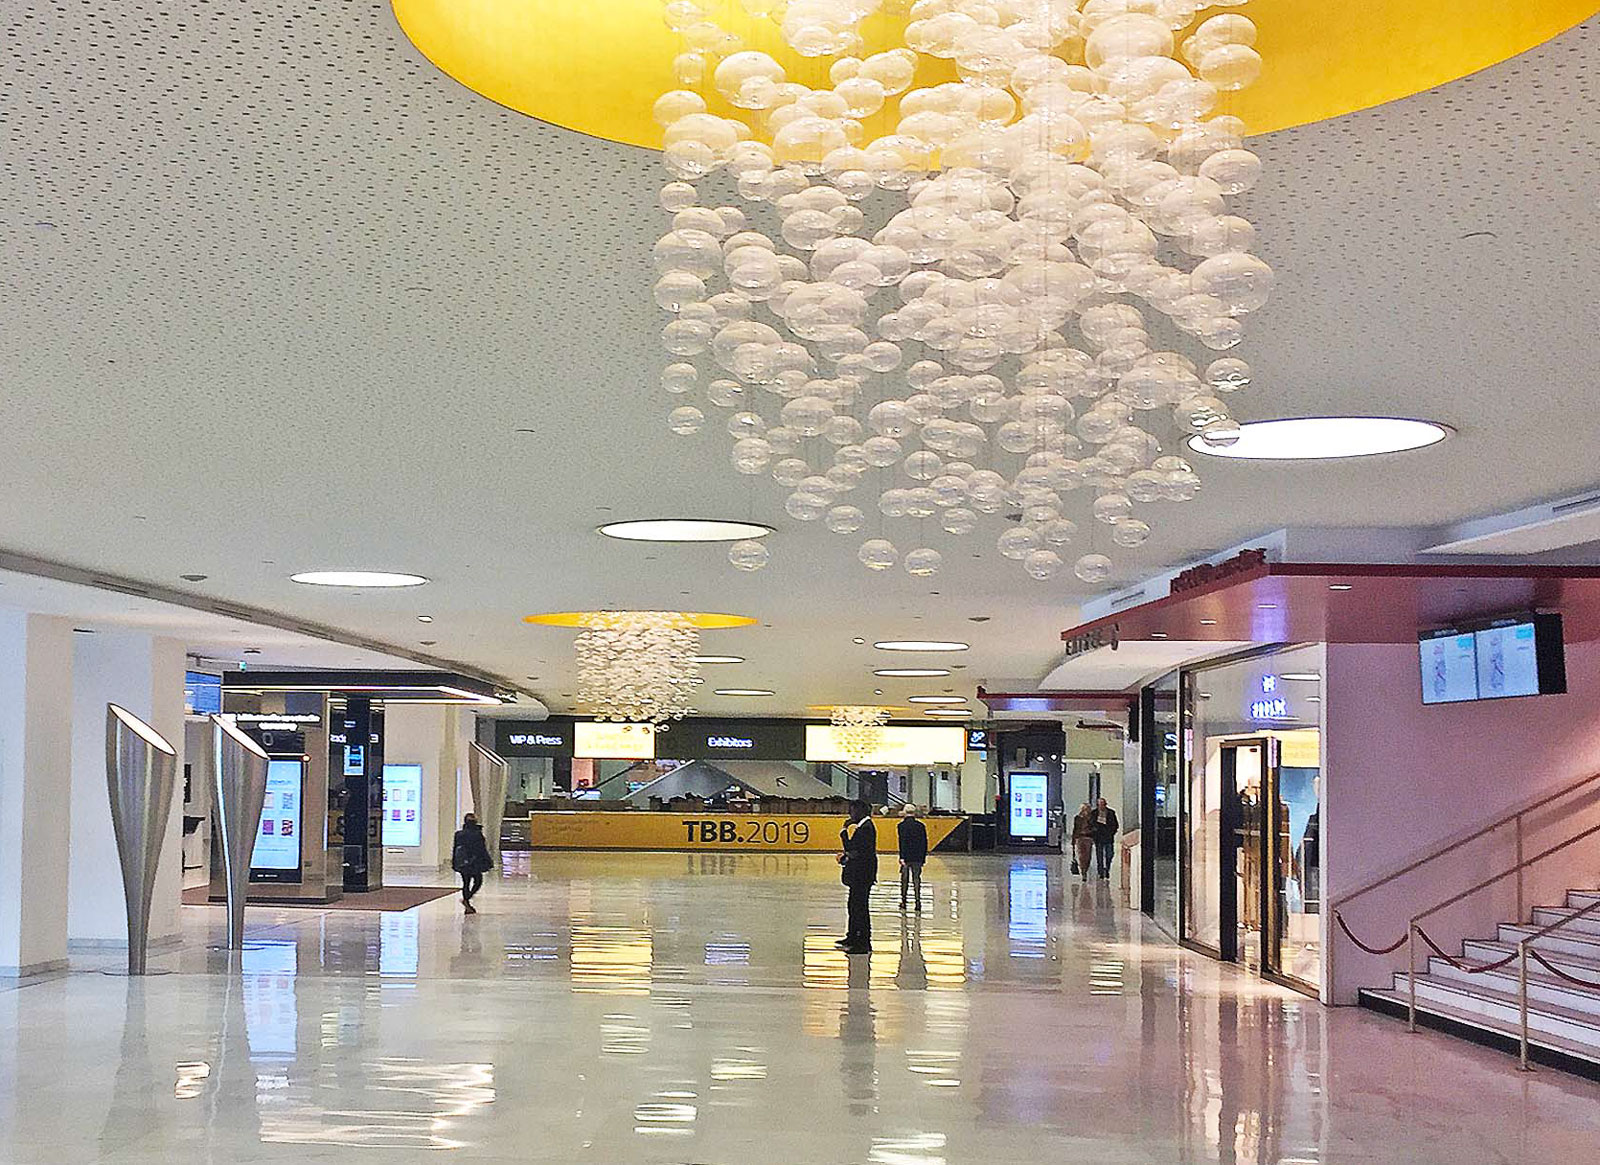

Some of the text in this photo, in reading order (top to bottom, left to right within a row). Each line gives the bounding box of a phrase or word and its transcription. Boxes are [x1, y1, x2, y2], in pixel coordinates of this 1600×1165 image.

[509, 735, 526, 746] VIP
[536, 735, 563, 746] Press
[707, 736, 753, 748] Exhibitors
[682, 820, 810, 844] TBB.2019
